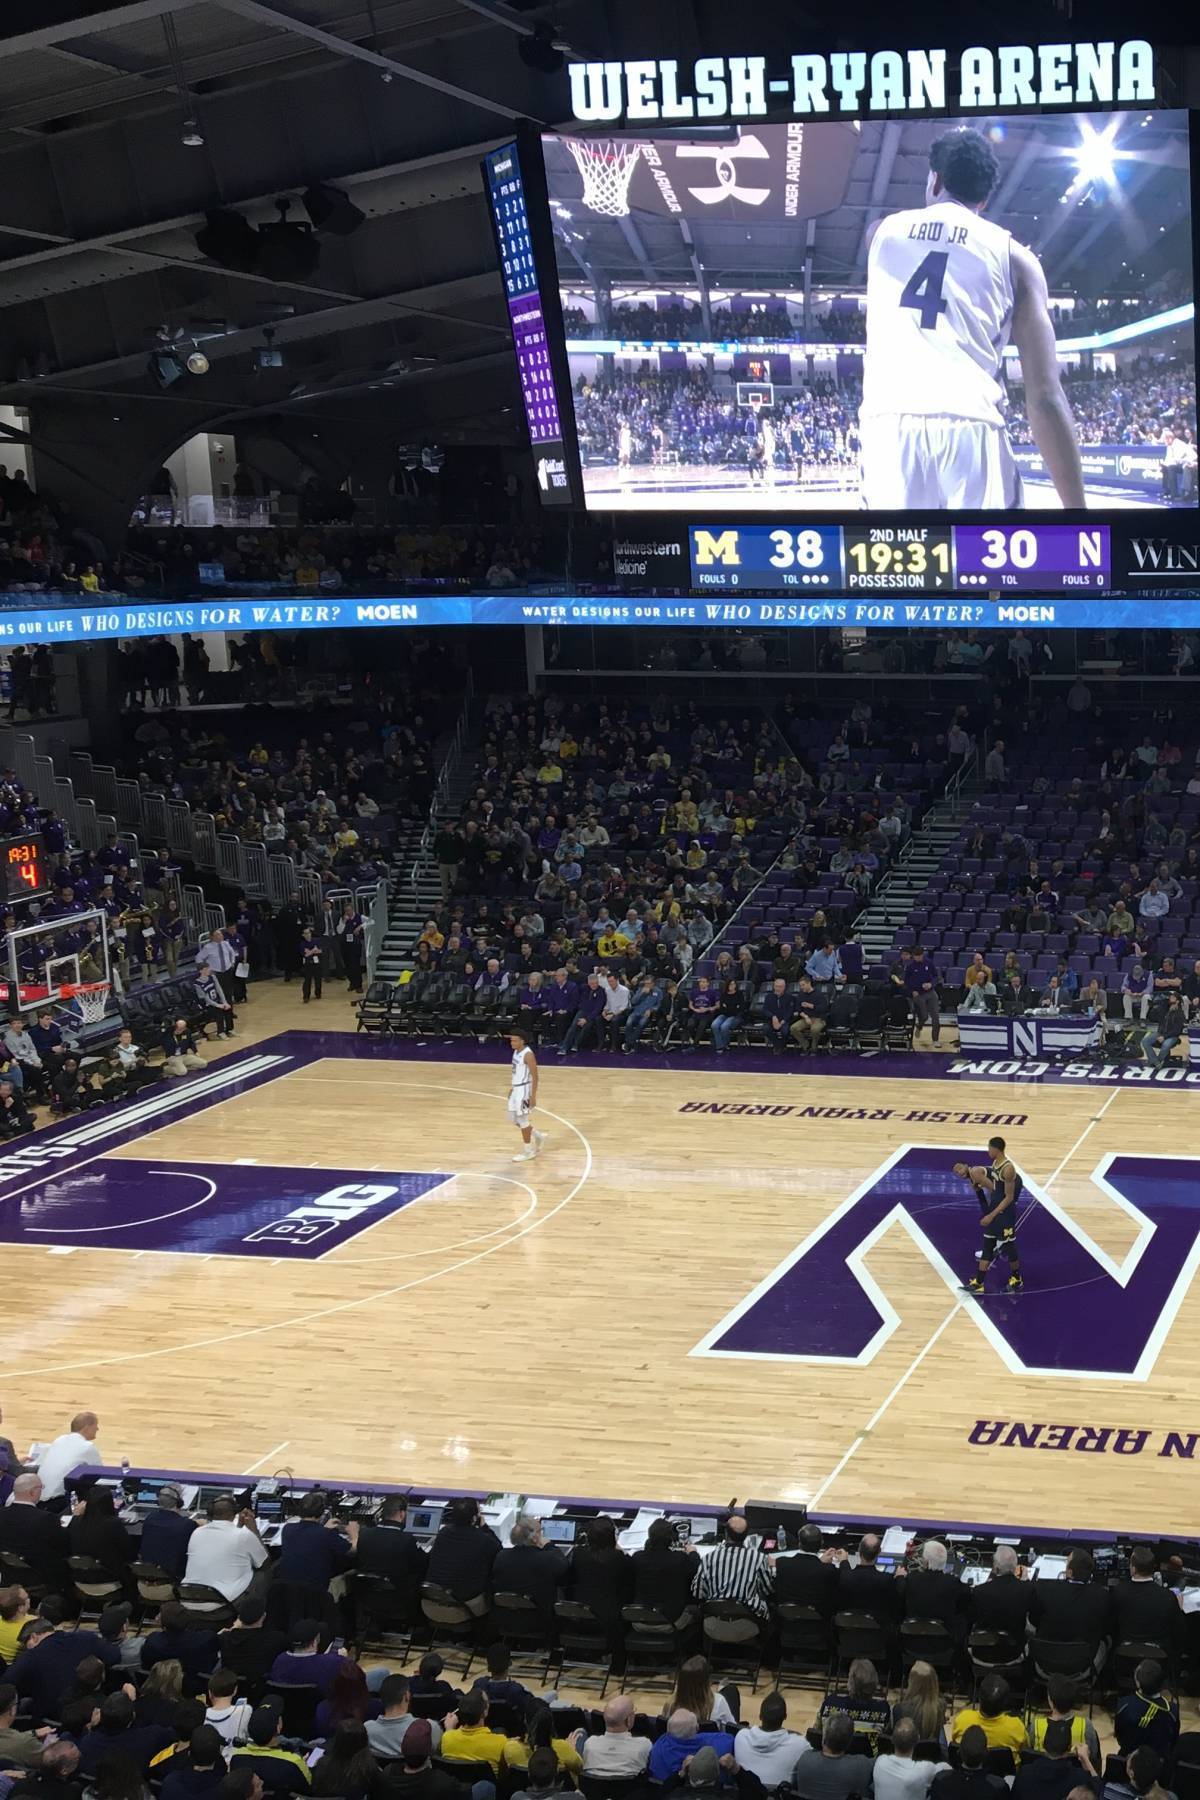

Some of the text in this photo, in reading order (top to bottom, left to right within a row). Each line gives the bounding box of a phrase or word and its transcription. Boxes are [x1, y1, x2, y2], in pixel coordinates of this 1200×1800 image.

[568, 39, 1155, 121] WELSH-RYAN ARENA
[785, 123, 804, 217] UNDER ARMOUR
[505, 203, 510, 216] 3
[513, 199, 518, 214] 2
[908, 221, 968, 245] LAW JR
[898, 250, 949, 327] 4
[694, 531, 741, 564] M
[870, 529, 928, 542] 2ND HALF
[768, 530, 824, 568] 38
[850, 542, 949, 573] 19:31
[980, 530, 1038, 568] 30
[1078, 532, 1101, 567] N
[700, 573, 738, 585] FOULS 0
[782, 574, 799, 584] TOL
[850, 574, 925, 588] POSSESSION
[1002, 575, 1018, 585] TOL
[1062, 575, 1104, 586] FOULS 0
[19, 620, 42, 634] OUR
[47, 619, 72, 633] LIFE
[80, 614, 119, 632] WHO
[125, 610, 195, 630] DESIGNS
[200, 608, 242, 626] FOR
[252, 606, 342, 624] WATER?
[356, 604, 418, 620] MOEN
[522, 604, 1056, 622] WATER DESIGNS OUR LIFE WHO DESIGNS FOR WATER? MOEN
[8, 845, 36, 864] 19:31
[21, 864, 36, 887] 4
[1012, 1021, 1038, 1057] N
[677, 1101, 1029, 1126] WELSH-RYAN ARENA
[967, 1420, 1152, 1456] ARENA
